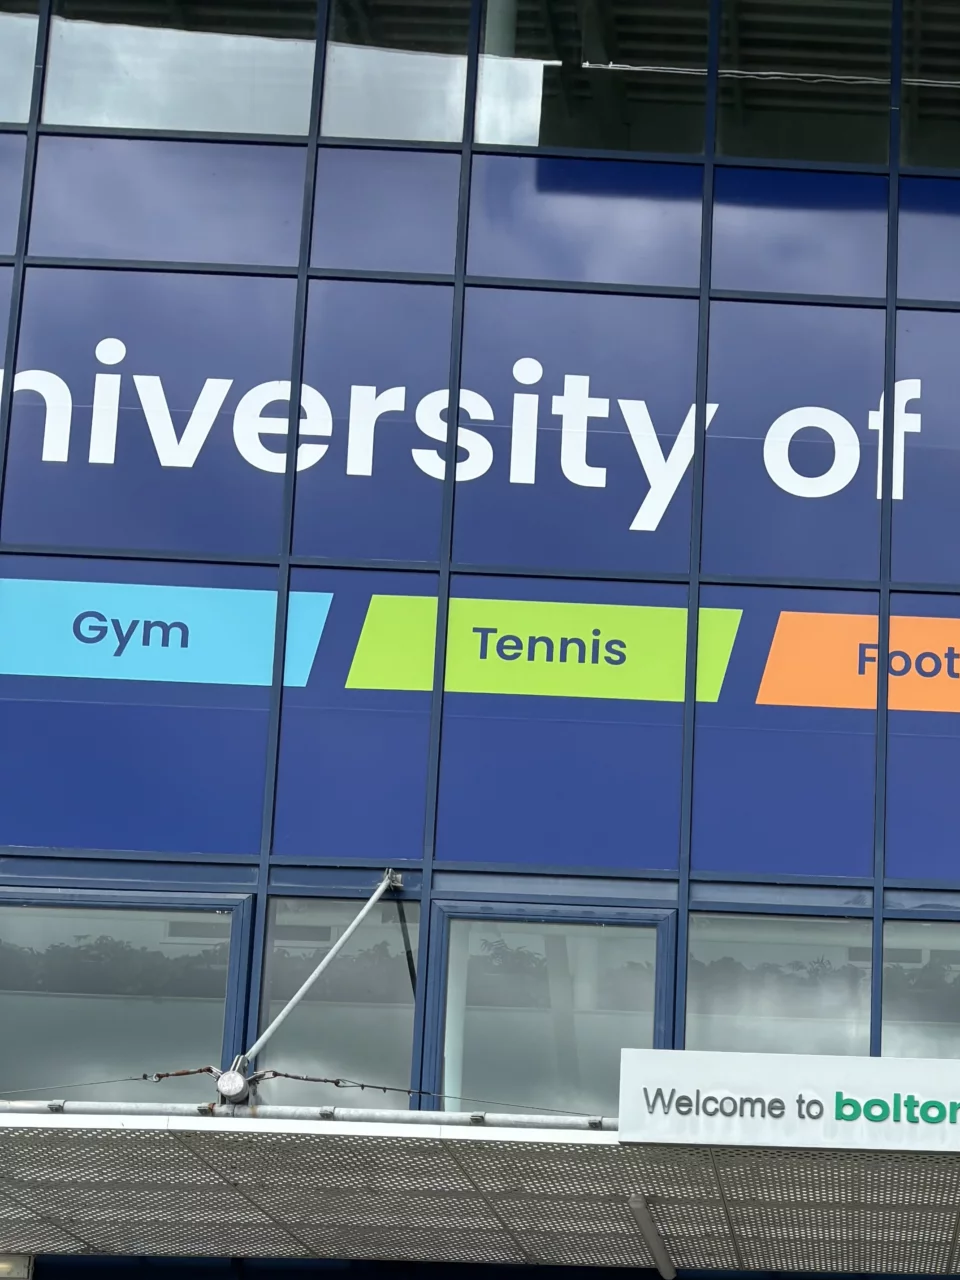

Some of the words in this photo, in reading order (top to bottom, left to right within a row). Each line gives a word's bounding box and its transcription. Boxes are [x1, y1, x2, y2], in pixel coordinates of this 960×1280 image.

[763, 379, 922, 500] of
[72, 610, 190, 657] Gym
[472, 626, 627, 665] Tennis
[643, 1086, 786, 1120] Welcome
[796, 1091, 824, 1120] to
